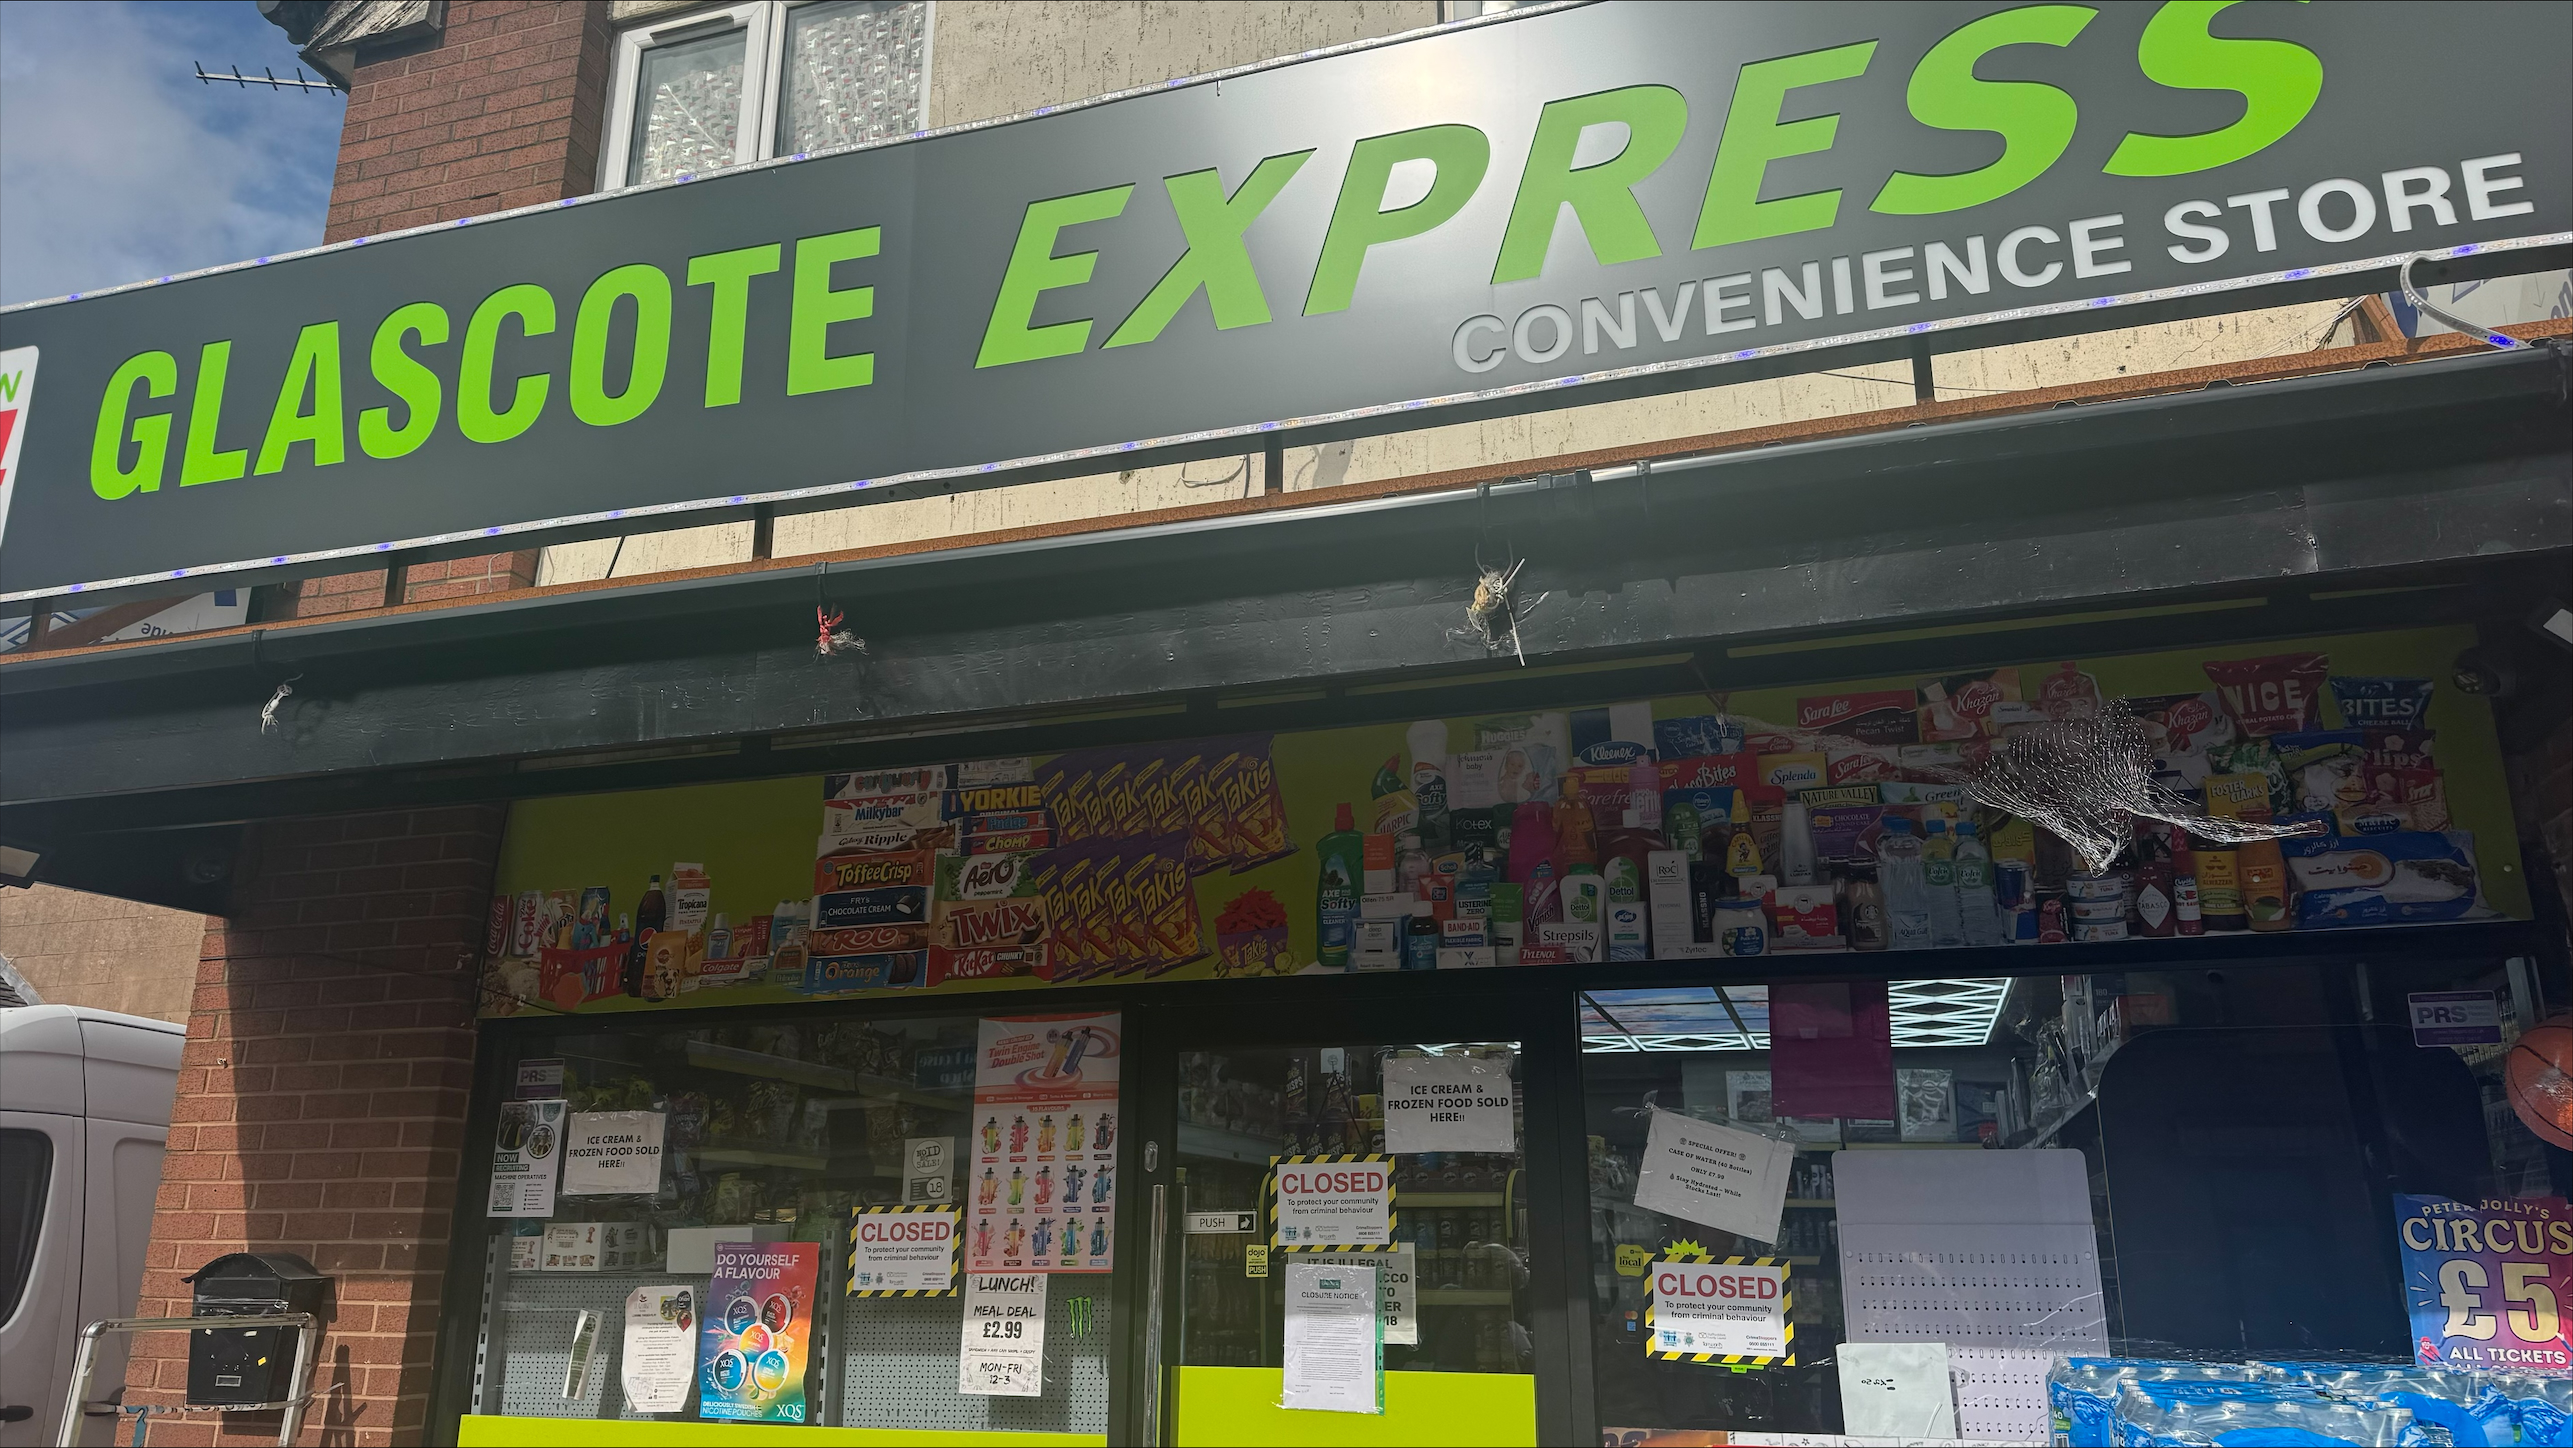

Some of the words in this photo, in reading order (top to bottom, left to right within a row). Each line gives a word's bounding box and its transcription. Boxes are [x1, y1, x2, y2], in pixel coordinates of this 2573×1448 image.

[90, 226, 881, 501] GLASCOTE
[974, 0, 2323, 369] EXPRESS
[1452, 212, 2132, 374] CONVENIENCE
[2164, 152, 2534, 264] STORE
[1956, 687, 2000, 715] Khazan
[2167, 704, 2209, 731] Khazan
[1481, 730, 1527, 744] HUGGIES
[1856, 727, 1881, 735] Pecan
[1590, 745, 1636, 761] Kleenex
[1771, 769, 1816, 785] Splenda
[1429, 783, 1444, 791] AXE
[2211, 780, 2245, 797] FOSTER
[960, 785, 1041, 812] YORKIE
[1801, 789, 1838, 807] NATURE
[1840, 787, 1876, 803] VALLEY
[855, 805, 904, 821] Milkybar
[1835, 814, 1870, 822] CHOCOLATE
[1455, 818, 1492, 830] Kotex
[864, 833, 907, 845] Ripple
[974, 889, 1003, 897] peppermint
[1322, 890, 1340, 898] AXE
[1609, 887, 1634, 896] Dettol
[678, 898, 707, 910] Tropicana
[1321, 898, 1357, 911] Softy
[1458, 901, 1492, 909] LISTERINE
[2138, 901, 2168, 909] TABASCO
[828, 907, 867, 916] CHOCOLATE
[868, 905, 891, 914] CREAM
[1447, 923, 1480, 933] BAND-AID
[1543, 930, 1594, 943] Strepsils
[997, 952, 1024, 960] CHUNKY
[1241, 939, 1268, 964] Takis
[1522, 949, 1556, 958] TYLENOL
[702, 963, 739, 973] Colgate
[825, 962, 880, 982] Orange
[2417, 1005, 2468, 1024] PRS
[989, 1047, 1011, 1058] Twin
[1012, 1043, 1040, 1054] Engine
[992, 1053, 1025, 1068] Double
[1025, 1051, 1044, 1062] Shot
[520, 1070, 547, 1083] PRS
[1410, 1086, 1427, 1095] ICE
[1431, 1084, 1472, 1095] CREAM
[1476, 1085, 1483, 1093] &
[1388, 1099, 1434, 1109] FROZEN
[1438, 1098, 1473, 1108] FOOD
[1477, 1097, 1509, 1107] SOLD
[1430, 1112, 1465, 1122] HERE!!
[587, 1136, 600, 1145] ICE
[602, 1135, 634, 1144] CREAM
[568, 1148, 603, 1158] FROZEN
[605, 1147, 632, 1156] FOOD
[635, 1146, 660, 1155] SOLD
[1688, 1140, 1713, 1152] SPECIAL
[1715, 1147, 1737, 1158] OFFER!
[496, 1154, 518, 1163] NOW
[598, 1160, 625, 1169] HERE!!
[1668, 1148, 1685, 1157] CASE
[1695, 1155, 1717, 1166] WATER
[1718, 1160, 1728, 1169] (40
[1729, 1163, 1752, 1176] Bottles)
[1690, 1166, 1708, 1176] ONLY
[929, 1182, 943, 1193] 18
[1282, 1172, 1383, 1194] CLOSED
[1676, 1175, 1689, 1184] Stay
[1690, 1178, 1718, 1192] Hydrated
[1724, 1188, 1742, 1198] While
[1685, 1185, 1705, 1194] Stocks
[1706, 1189, 1721, 1199] Last!
[1297, 1199, 1321, 1207] protect
[2481, 1199, 2550, 1219] JOLLY'S
[1200, 1218, 1225, 1228] PUSH
[861, 1221, 950, 1242] CLOSED
[2402, 1216, 2573, 1255] CIRCUS
[873, 1246, 894, 1254] protect
[1248, 1249, 1265, 1257] dojo
[716, 1254, 736, 1265] DO
[739, 1254, 799, 1267] YOURSELF
[1619, 1257, 1641, 1267] local
[714, 1268, 723, 1279] A
[725, 1267, 781, 1280] FLAVOUR
[1249, 1266, 1266, 1274] PUSH
[979, 1277, 1036, 1292] LUNCH!
[1658, 1273, 1777, 1299] CLOSED
[1334, 1292, 1359, 1300] NOTICE
[2438, 1259, 2560, 1343] £5
[732, 1305, 748, 1315] XQS
[769, 1300, 782, 1313] XQS
[974, 1306, 1004, 1317] MEAL
[1007, 1307, 1036, 1318] DEAL
[1676, 1302, 1705, 1310] protect
[1727, 1304, 1772, 1313] community
[1726, 1314, 1766, 1322] behaviour
[983, 1321, 1022, 1338] £2.99
[751, 1330, 764, 1342] XQS
[2450, 1347, 2483, 1360] ALL
[2487, 1348, 2566, 1364] TICKETS
[720, 1358, 734, 1368] XQS
[767, 1356, 780, 1369] XQS
[980, 1362, 1022, 1374] MON-FRI
[989, 1375, 1011, 1385] 12-3
[702, 1401, 734, 1409] DELICIOUSLY
[702, 1407, 732, 1417] NICOTINE
[732, 1408, 763, 1418] POUCHES
[776, 1403, 804, 1421] XQS
